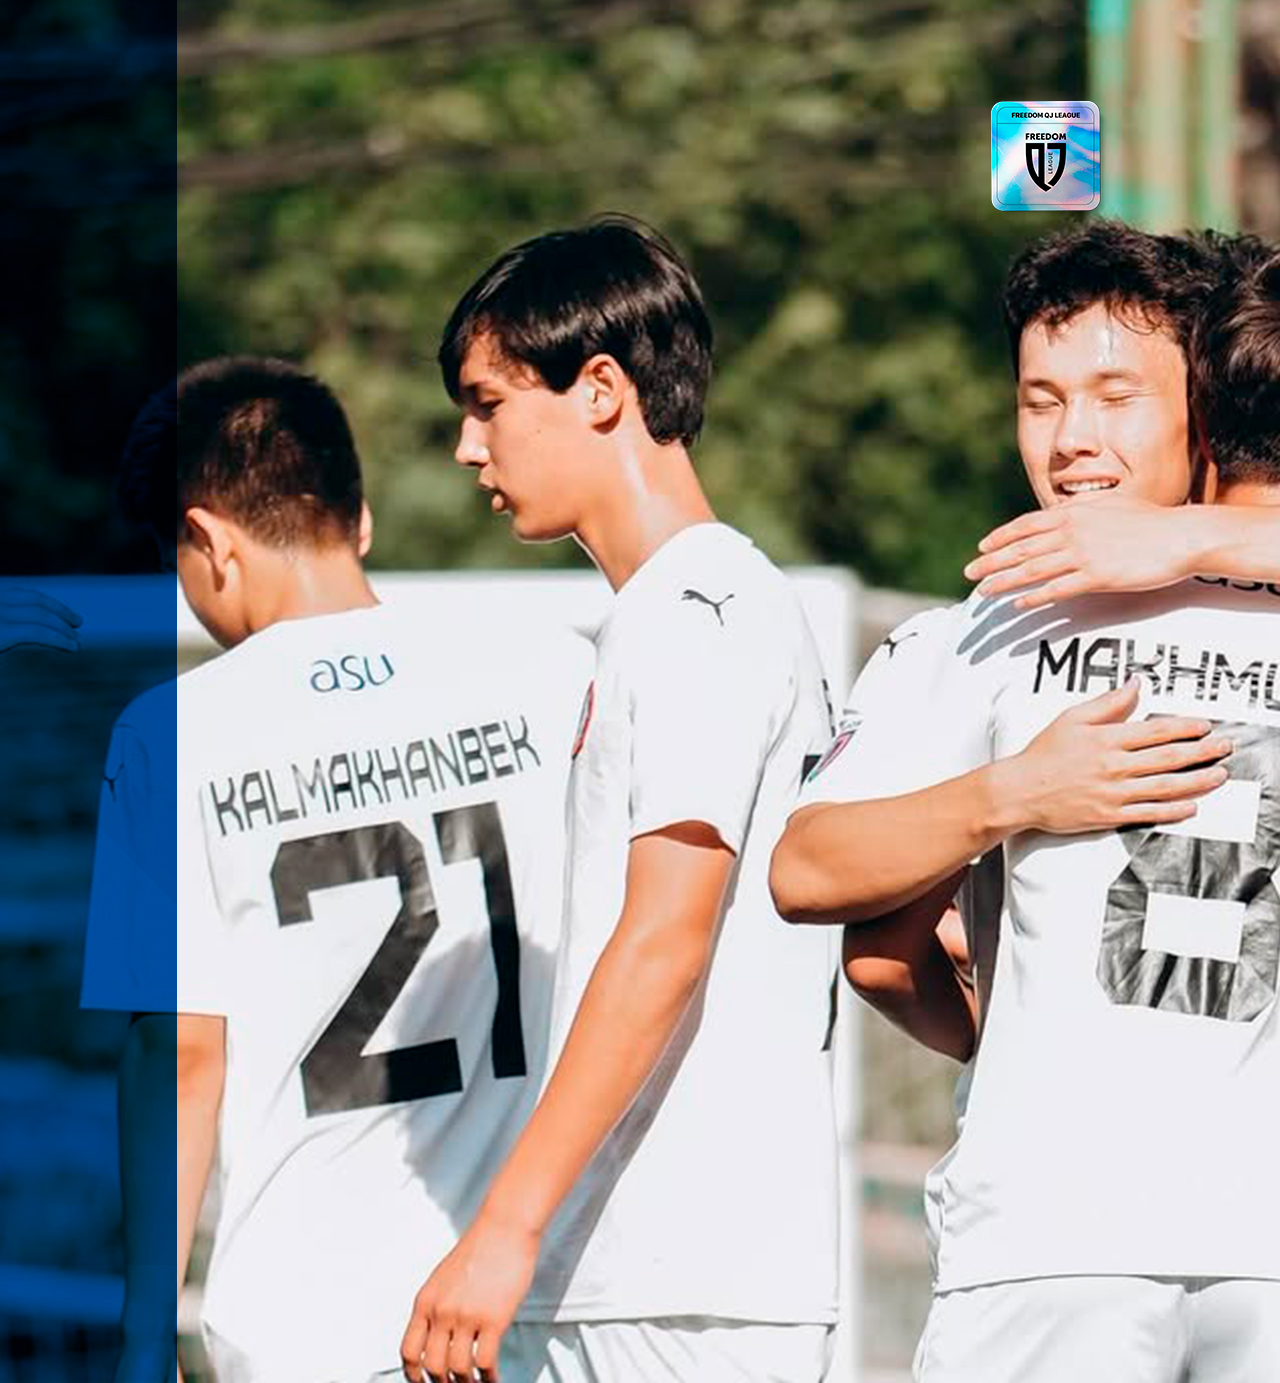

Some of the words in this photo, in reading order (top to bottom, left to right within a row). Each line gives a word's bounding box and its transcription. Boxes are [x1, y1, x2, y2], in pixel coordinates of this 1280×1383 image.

[308, 650, 396, 693] asu
[208, 715, 541, 836] KALMAKHANBEK
[270, 801, 527, 1118] 21
